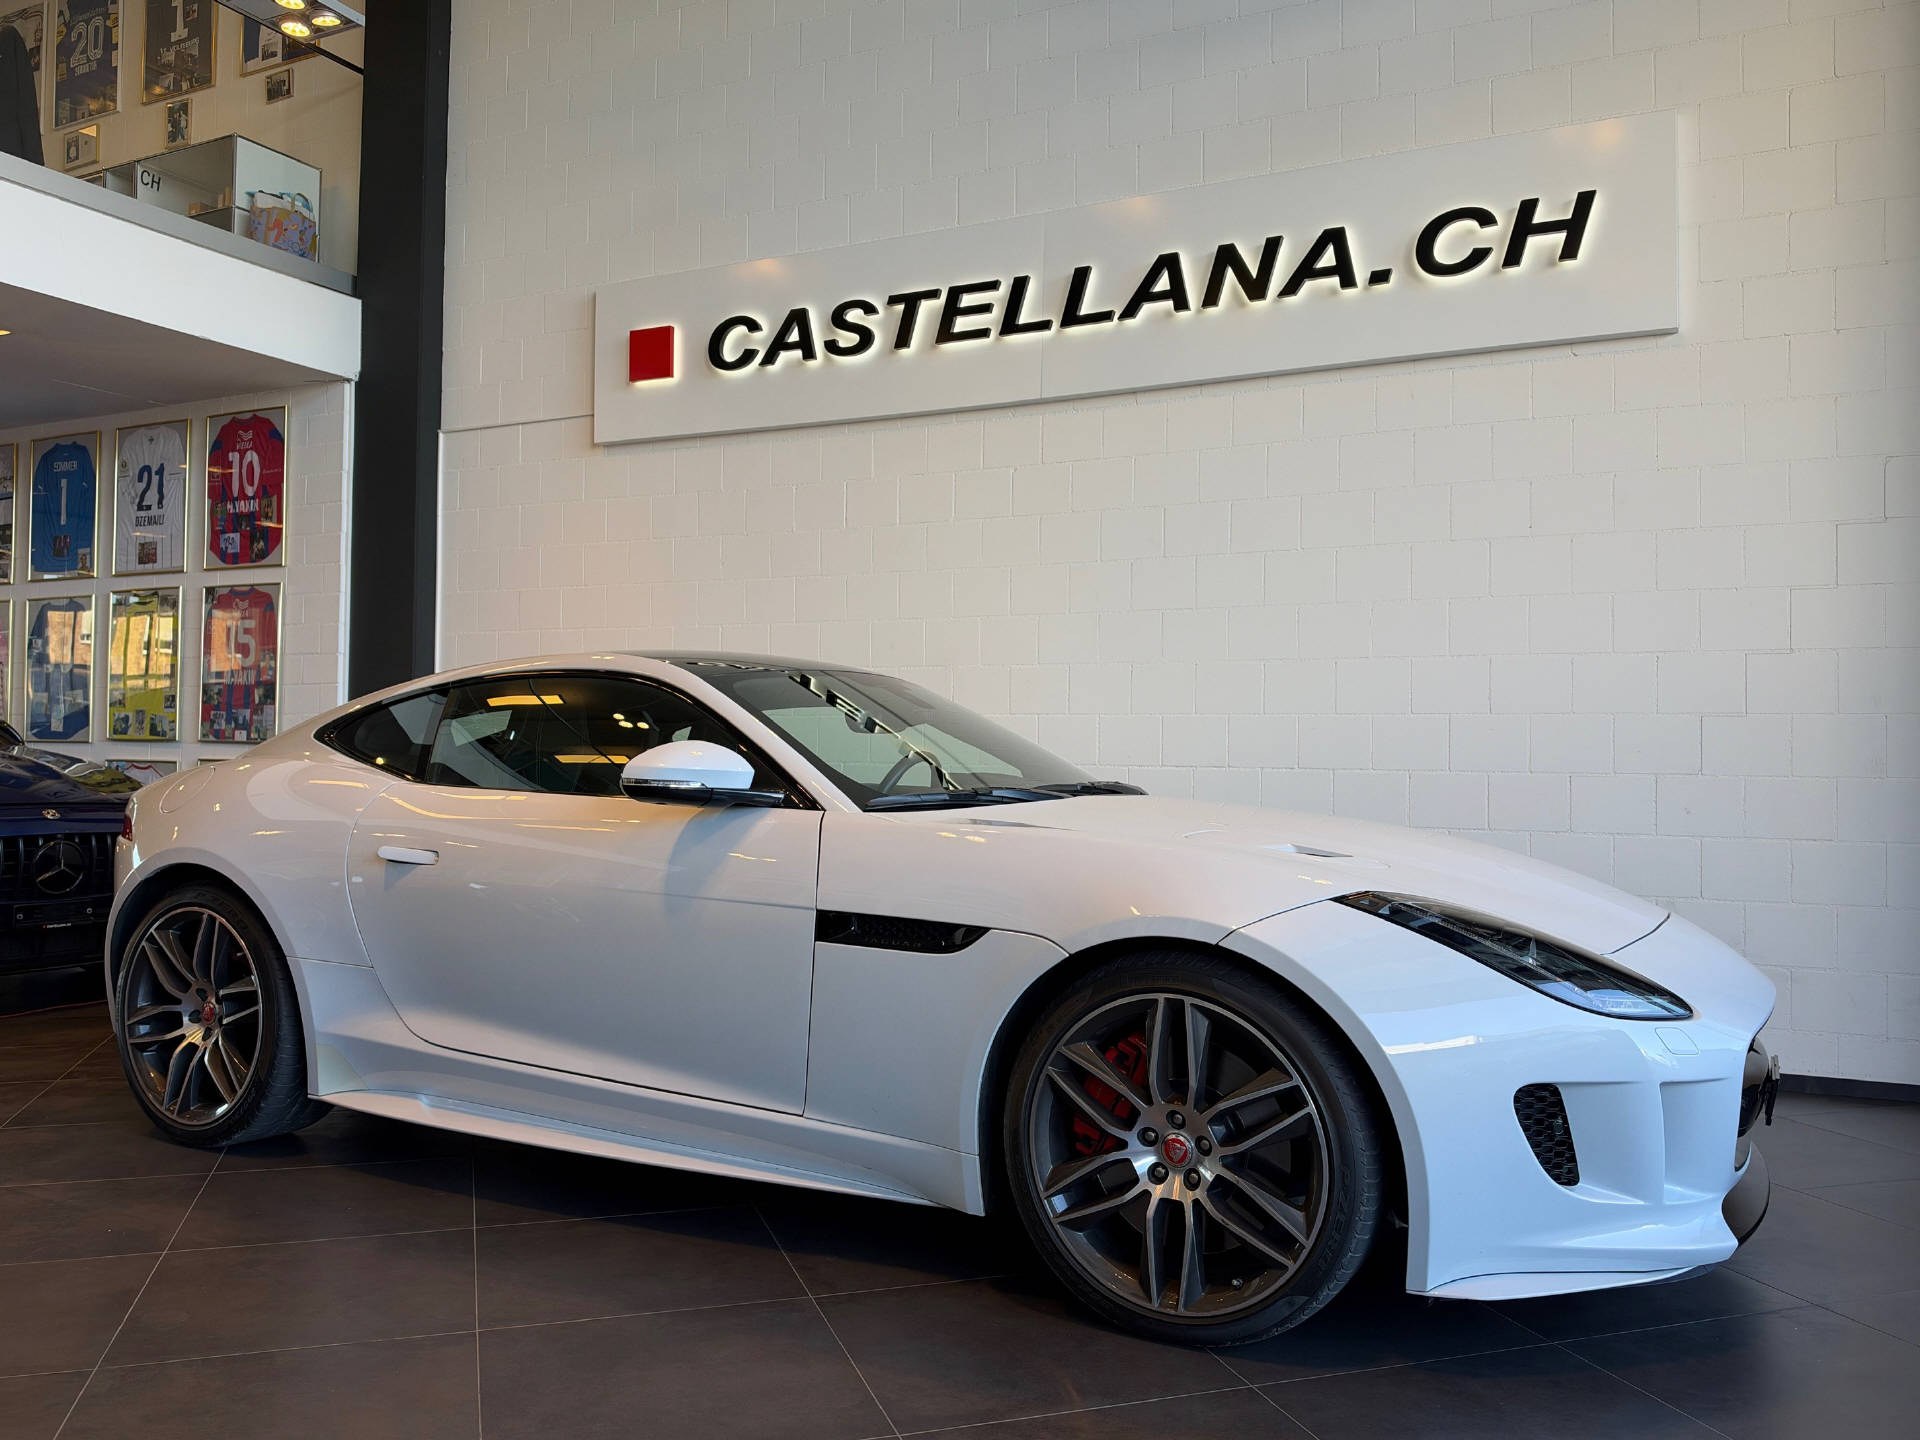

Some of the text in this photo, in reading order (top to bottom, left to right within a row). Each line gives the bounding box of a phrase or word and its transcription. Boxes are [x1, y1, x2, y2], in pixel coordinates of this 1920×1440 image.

[70, 15, 104, 68] 20
[140, 170, 162, 192] CH
[708, 190, 1596, 370] CASTELLANA.CH
[53, 460, 78, 472] SOMMER
[137, 463, 165, 511] 21
[228, 450, 261, 497] 10
[226, 619, 256, 667] 15
